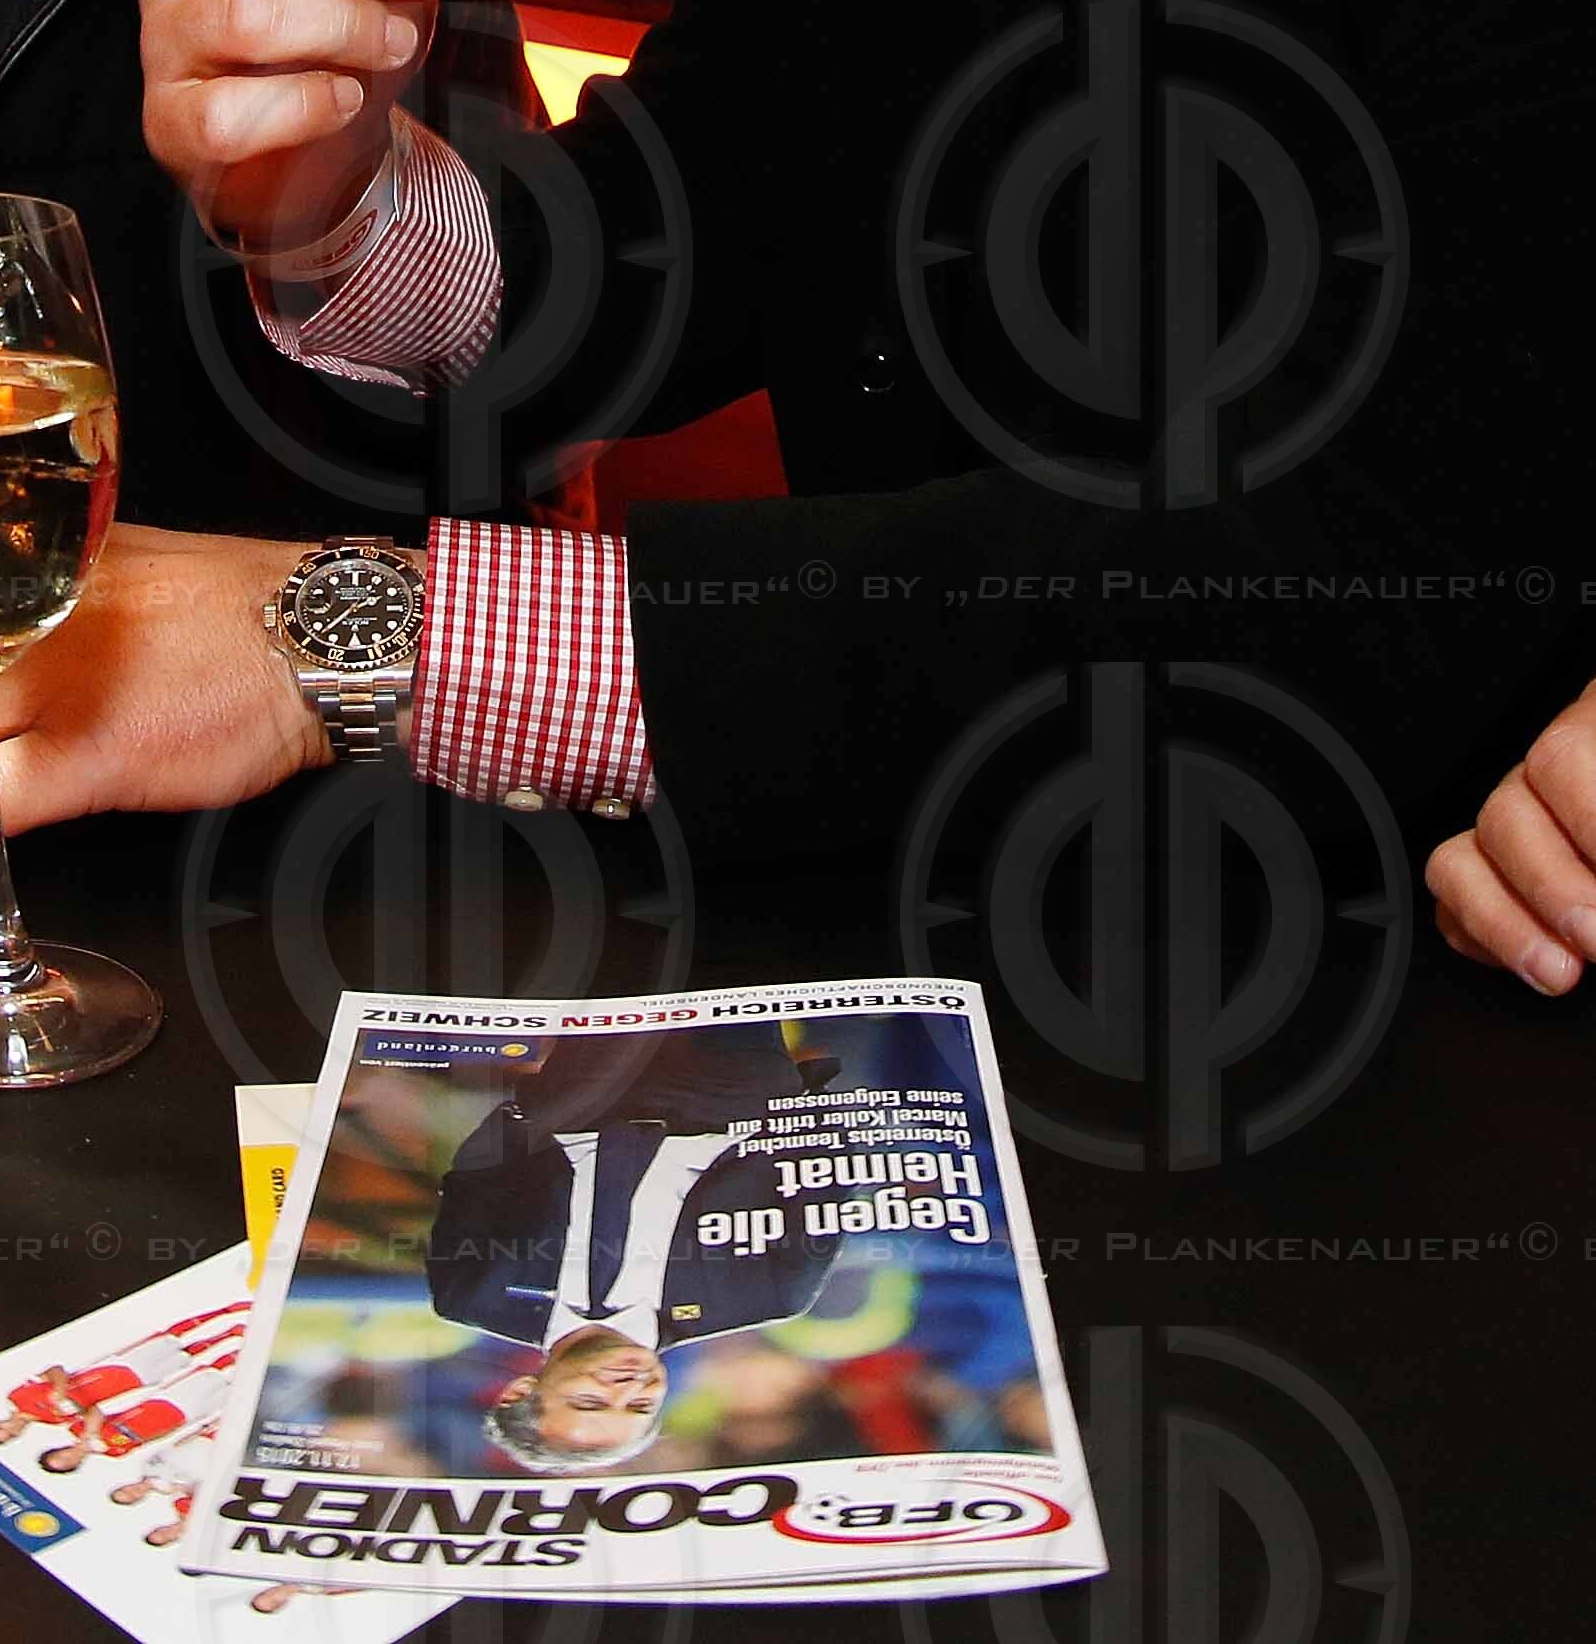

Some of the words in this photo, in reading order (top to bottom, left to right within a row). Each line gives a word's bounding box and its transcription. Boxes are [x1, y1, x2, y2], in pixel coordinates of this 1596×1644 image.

[362, 1008, 548, 1028] SCHWEIZ
[712, 994, 967, 1018] ÖSTERREICH
[561, 1009, 699, 1028] GEGEN
[376, 1040, 497, 1055] burgenland
[767, 1088, 902, 1112] Eidgenossen
[906, 1089, 964, 1105] seine
[726, 1118, 762, 1137] auf
[768, 1114, 817, 1132] trifft
[821, 1110, 891, 1128] Koller
[892, 1109, 968, 1127] Marcel
[737, 1131, 845, 1158] Teamchef
[848, 1127, 972, 1151] Österreichs
[774, 1151, 983, 1198] Heimat
[804, 1186, 991, 1245] Gegen
[697, 1206, 785, 1256] die
[218, 1474, 800, 1535] CORNER
[232, 1526, 587, 1566] STADION
